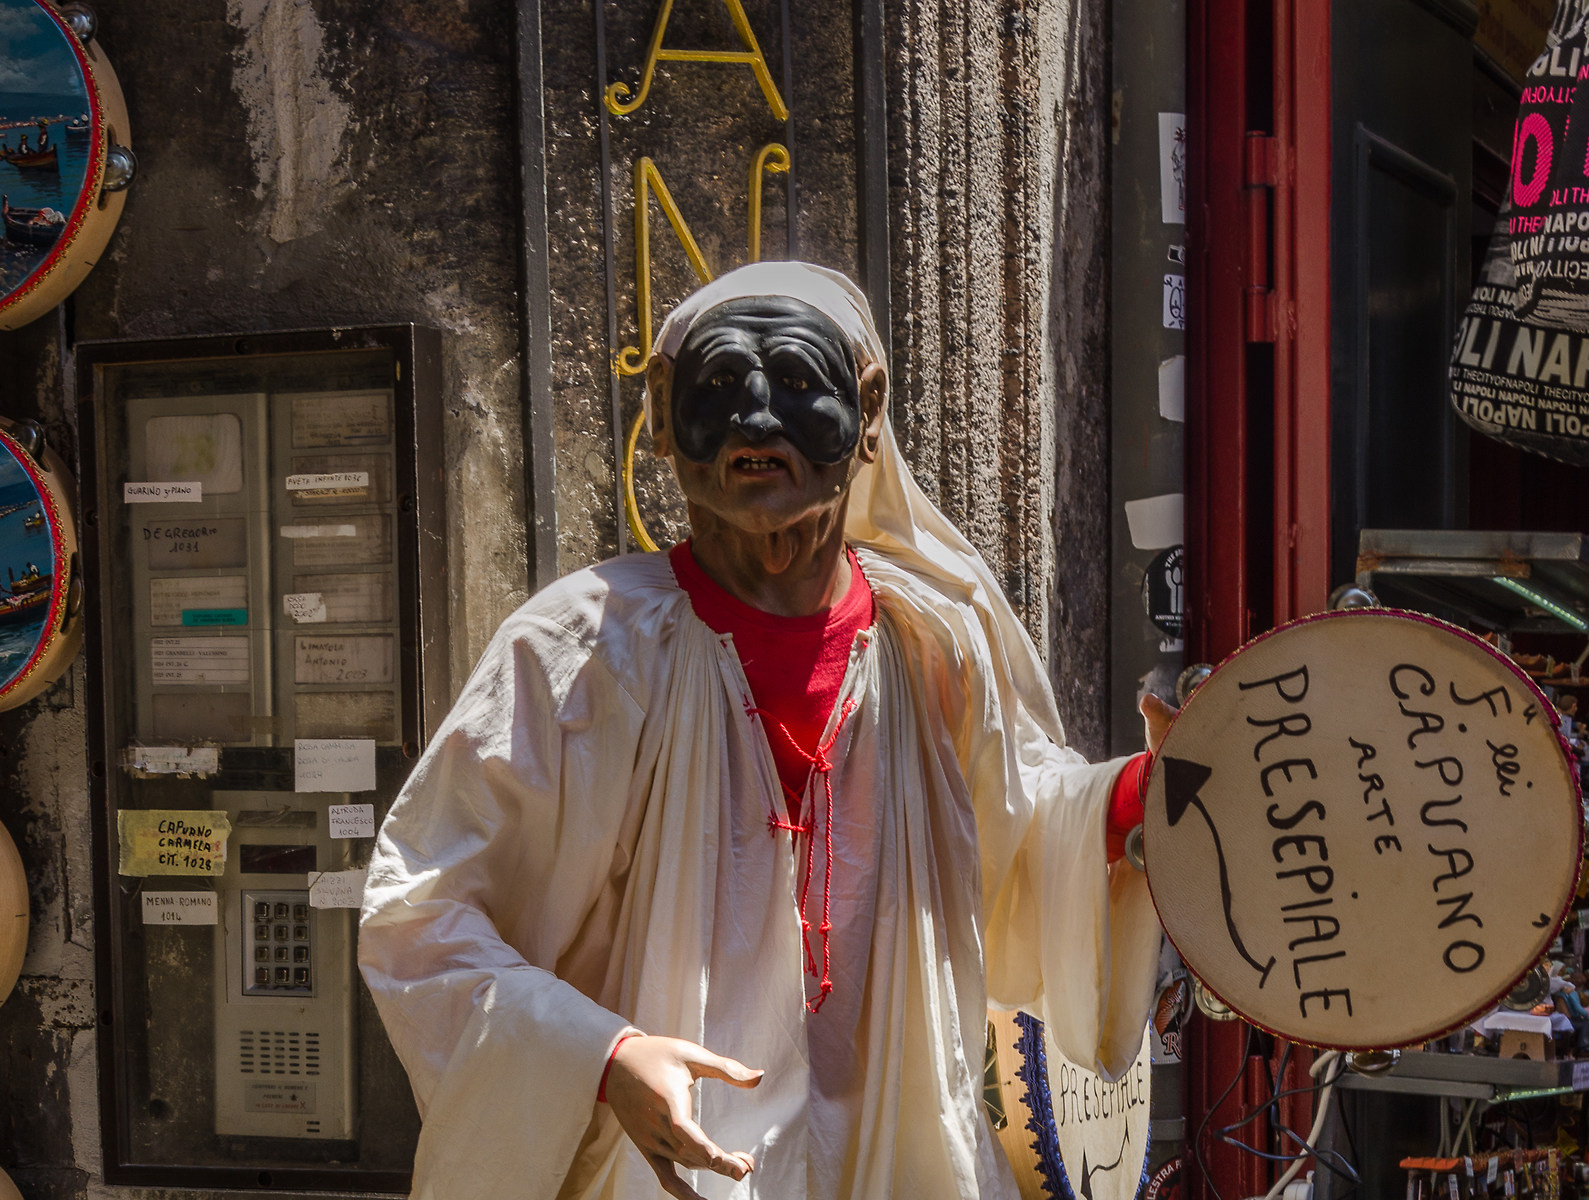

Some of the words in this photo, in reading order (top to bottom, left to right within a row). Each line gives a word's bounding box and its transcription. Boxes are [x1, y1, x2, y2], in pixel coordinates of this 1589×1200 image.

[1463, 382, 1496, 399] NAPOLI
[1498, 390, 1535, 407] NAPOLI
[1538, 398, 1576, 414] NAPOLI
[158, 819, 212, 838] CAPUANO
[1348, 736, 1402, 856] ARTE
[1388, 662, 1486, 974] CAPUANO
[158, 837, 211, 853] CARMELA
[1237, 664, 1358, 1019] PRESEPIALE
